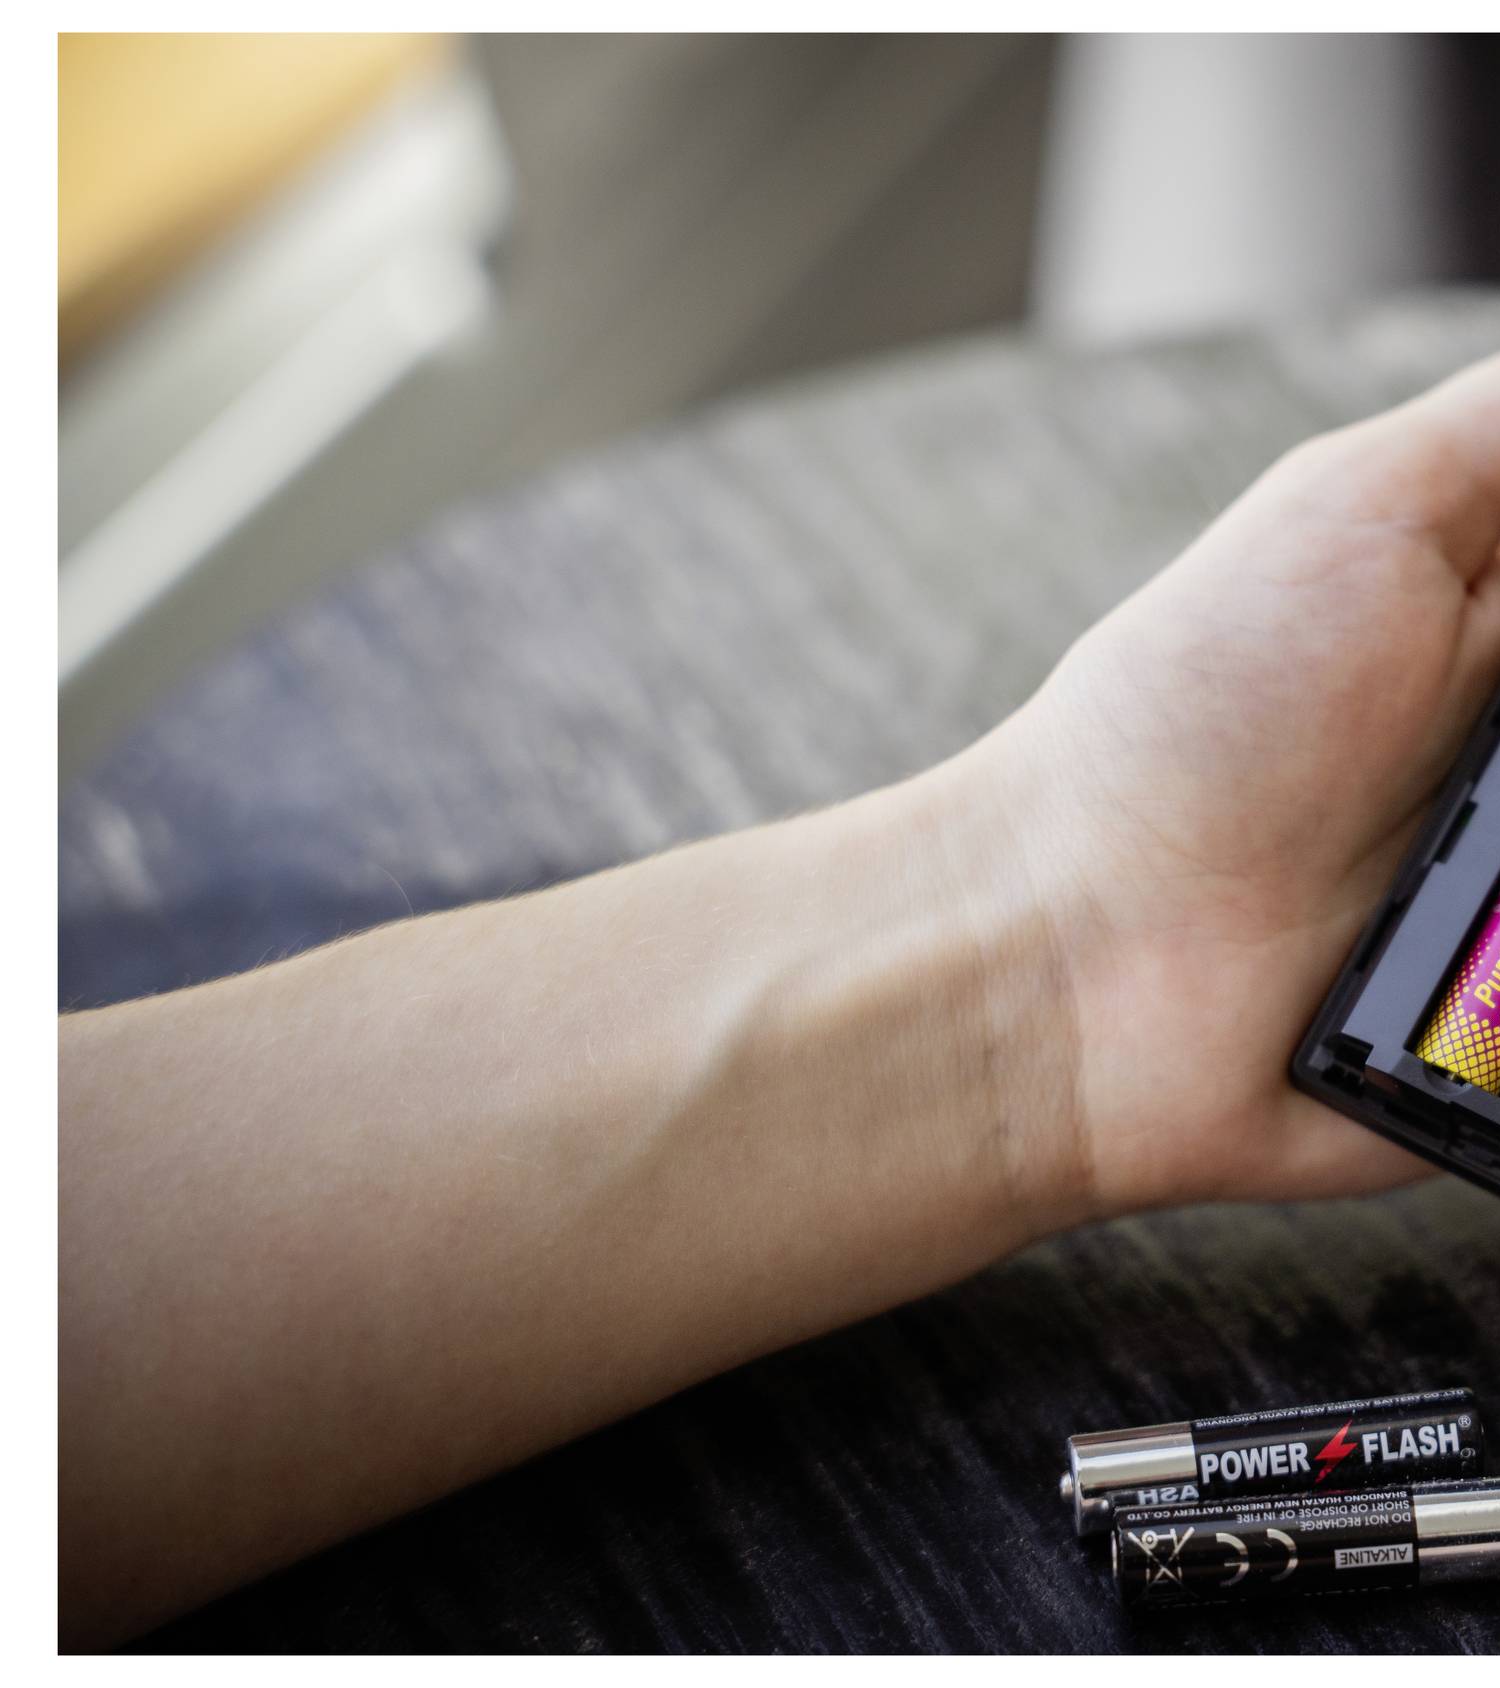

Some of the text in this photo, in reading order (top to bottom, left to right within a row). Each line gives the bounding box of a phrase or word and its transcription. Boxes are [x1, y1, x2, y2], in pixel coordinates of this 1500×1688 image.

[1196, 1415, 1257, 1428] SHANDONG
[1260, 1409, 1298, 1421] HUATAI
[1301, 1405, 1325, 1416] NEW
[1327, 1400, 1372, 1412] ENERGY
[1374, 1393, 1422, 1406] BATTERY
[1201, 1442, 1310, 1484] POWER
[1302, 1496, 1341, 1505] HUATAI
[1344, 1490, 1406, 1502] SHANDONG
[1225, 1501, 1271, 1512] ENERGY
[1274, 1499, 1298, 1508] NEW
[1173, 1505, 1222, 1516] BATTERY
[1236, 1499, 1409, 1523] SHORT OR DISPOSE OF IN FIRE
[1391, 1511, 1411, 1522] DO
[1363, 1513, 1388, 1525] NOT
[1339, 1548, 1408, 1566] ALKALINE
